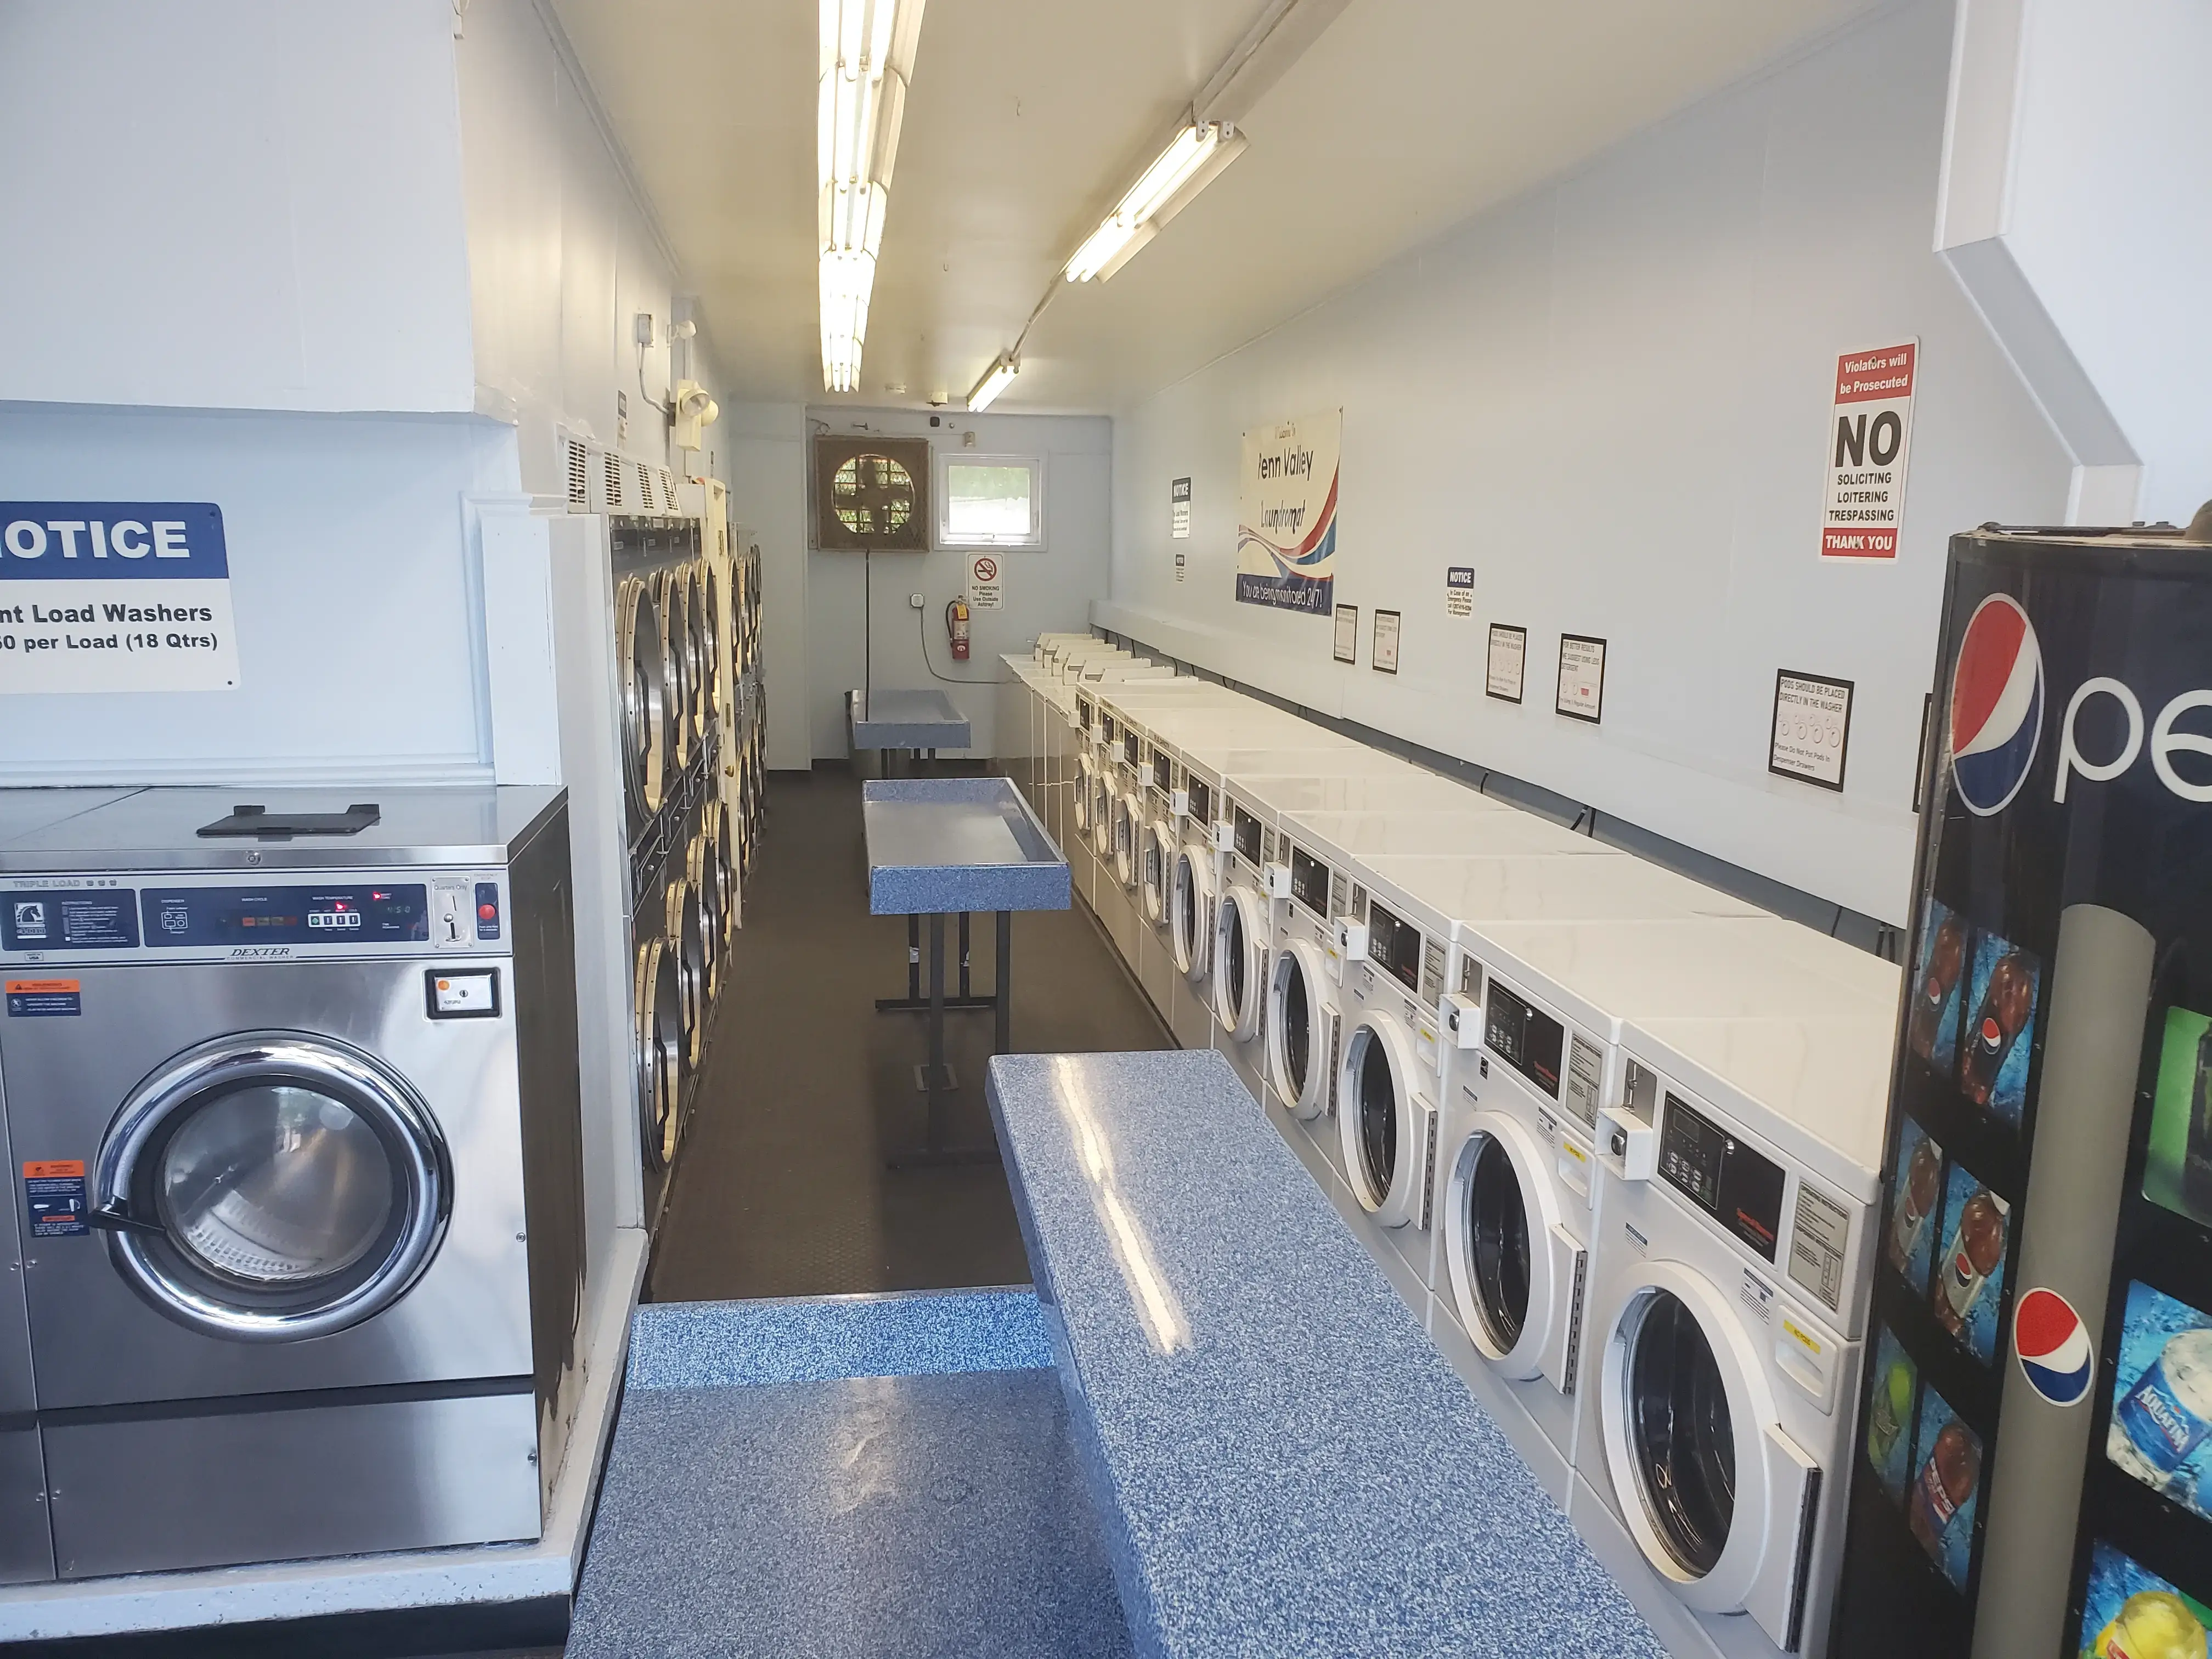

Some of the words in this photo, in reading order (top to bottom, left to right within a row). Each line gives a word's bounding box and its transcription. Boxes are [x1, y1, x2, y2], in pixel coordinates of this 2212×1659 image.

[1844, 357, 1887, 374] Violators
[1889, 352, 1907, 367] will
[1839, 382, 1851, 395] be
[1853, 374, 1908, 394] Prosecuted
[1835, 410, 1902, 468] NO
[1284, 444, 1314, 481] Valley
[1837, 472, 1892, 486] SOLICITING
[1173, 482, 1189, 497] NOTICE
[1837, 491, 1888, 504] LOITERING
[1260, 499, 1306, 535] Laundromat
[1829, 509, 1894, 522] TRESPASSING
[0, 520, 190, 558] OTICE
[1825, 535, 1864, 550] THANK
[1867, 535, 1893, 550] YOU
[1449, 571, 1471, 583] NOTICE
[1242, 582, 1252, 598] You
[1260, 583, 1277, 606] being
[1276, 585, 1306, 606] monitored
[1307, 587, 1322, 609] 24/7!
[32, 604, 95, 623] Load
[103, 603, 213, 623] Washers
[0, 635, 15, 650] 0
[24, 639, 59, 653] per
[66, 634, 119, 650] Load
[126, 633, 159, 652] (18
[166, 633, 218, 652] Qtrs)
[1781, 679, 1794, 690] PODS
[1795, 681, 1815, 694] SHOULD
[1816, 686, 1824, 695] BE
[1824, 687, 1845, 699] PLACED
[1779, 692, 1802, 704] DIRECTLY
[1803, 696, 1809, 706] IN
[1809, 698, 1820, 709] THE
[1820, 700, 1843, 713] WASHER
[1789, 746, 1796, 754] Do
[1813, 752, 1825, 761] Pods
[13, 879, 49, 888] TRIPLE
[230, 947, 290, 956] DEXTER
[2135, 1384, 2190, 1453] AQUAFINA
[1929, 1457, 1956, 1515] PEPSI
